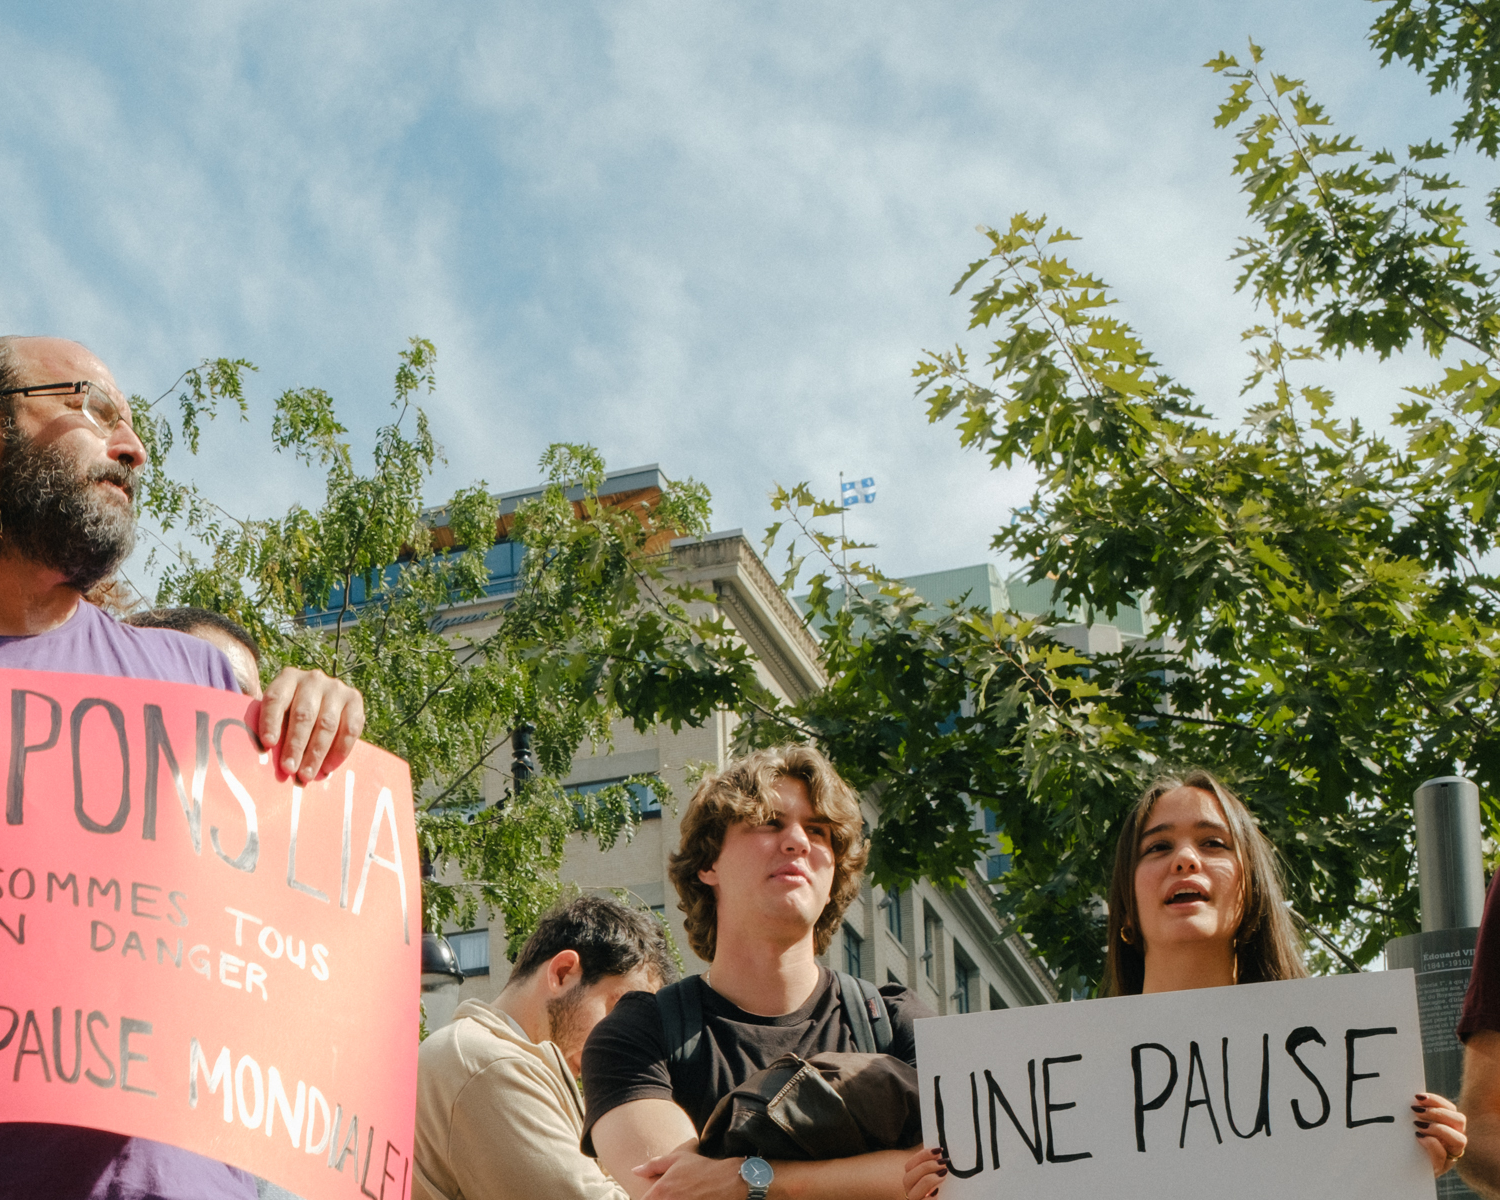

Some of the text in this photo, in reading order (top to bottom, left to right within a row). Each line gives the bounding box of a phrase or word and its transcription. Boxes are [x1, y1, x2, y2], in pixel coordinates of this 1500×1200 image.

[91, 920, 268, 1001] DANGER
[224, 907, 330, 982] TOUS
[933, 1025, 1398, 1179] UNE PAUSE
